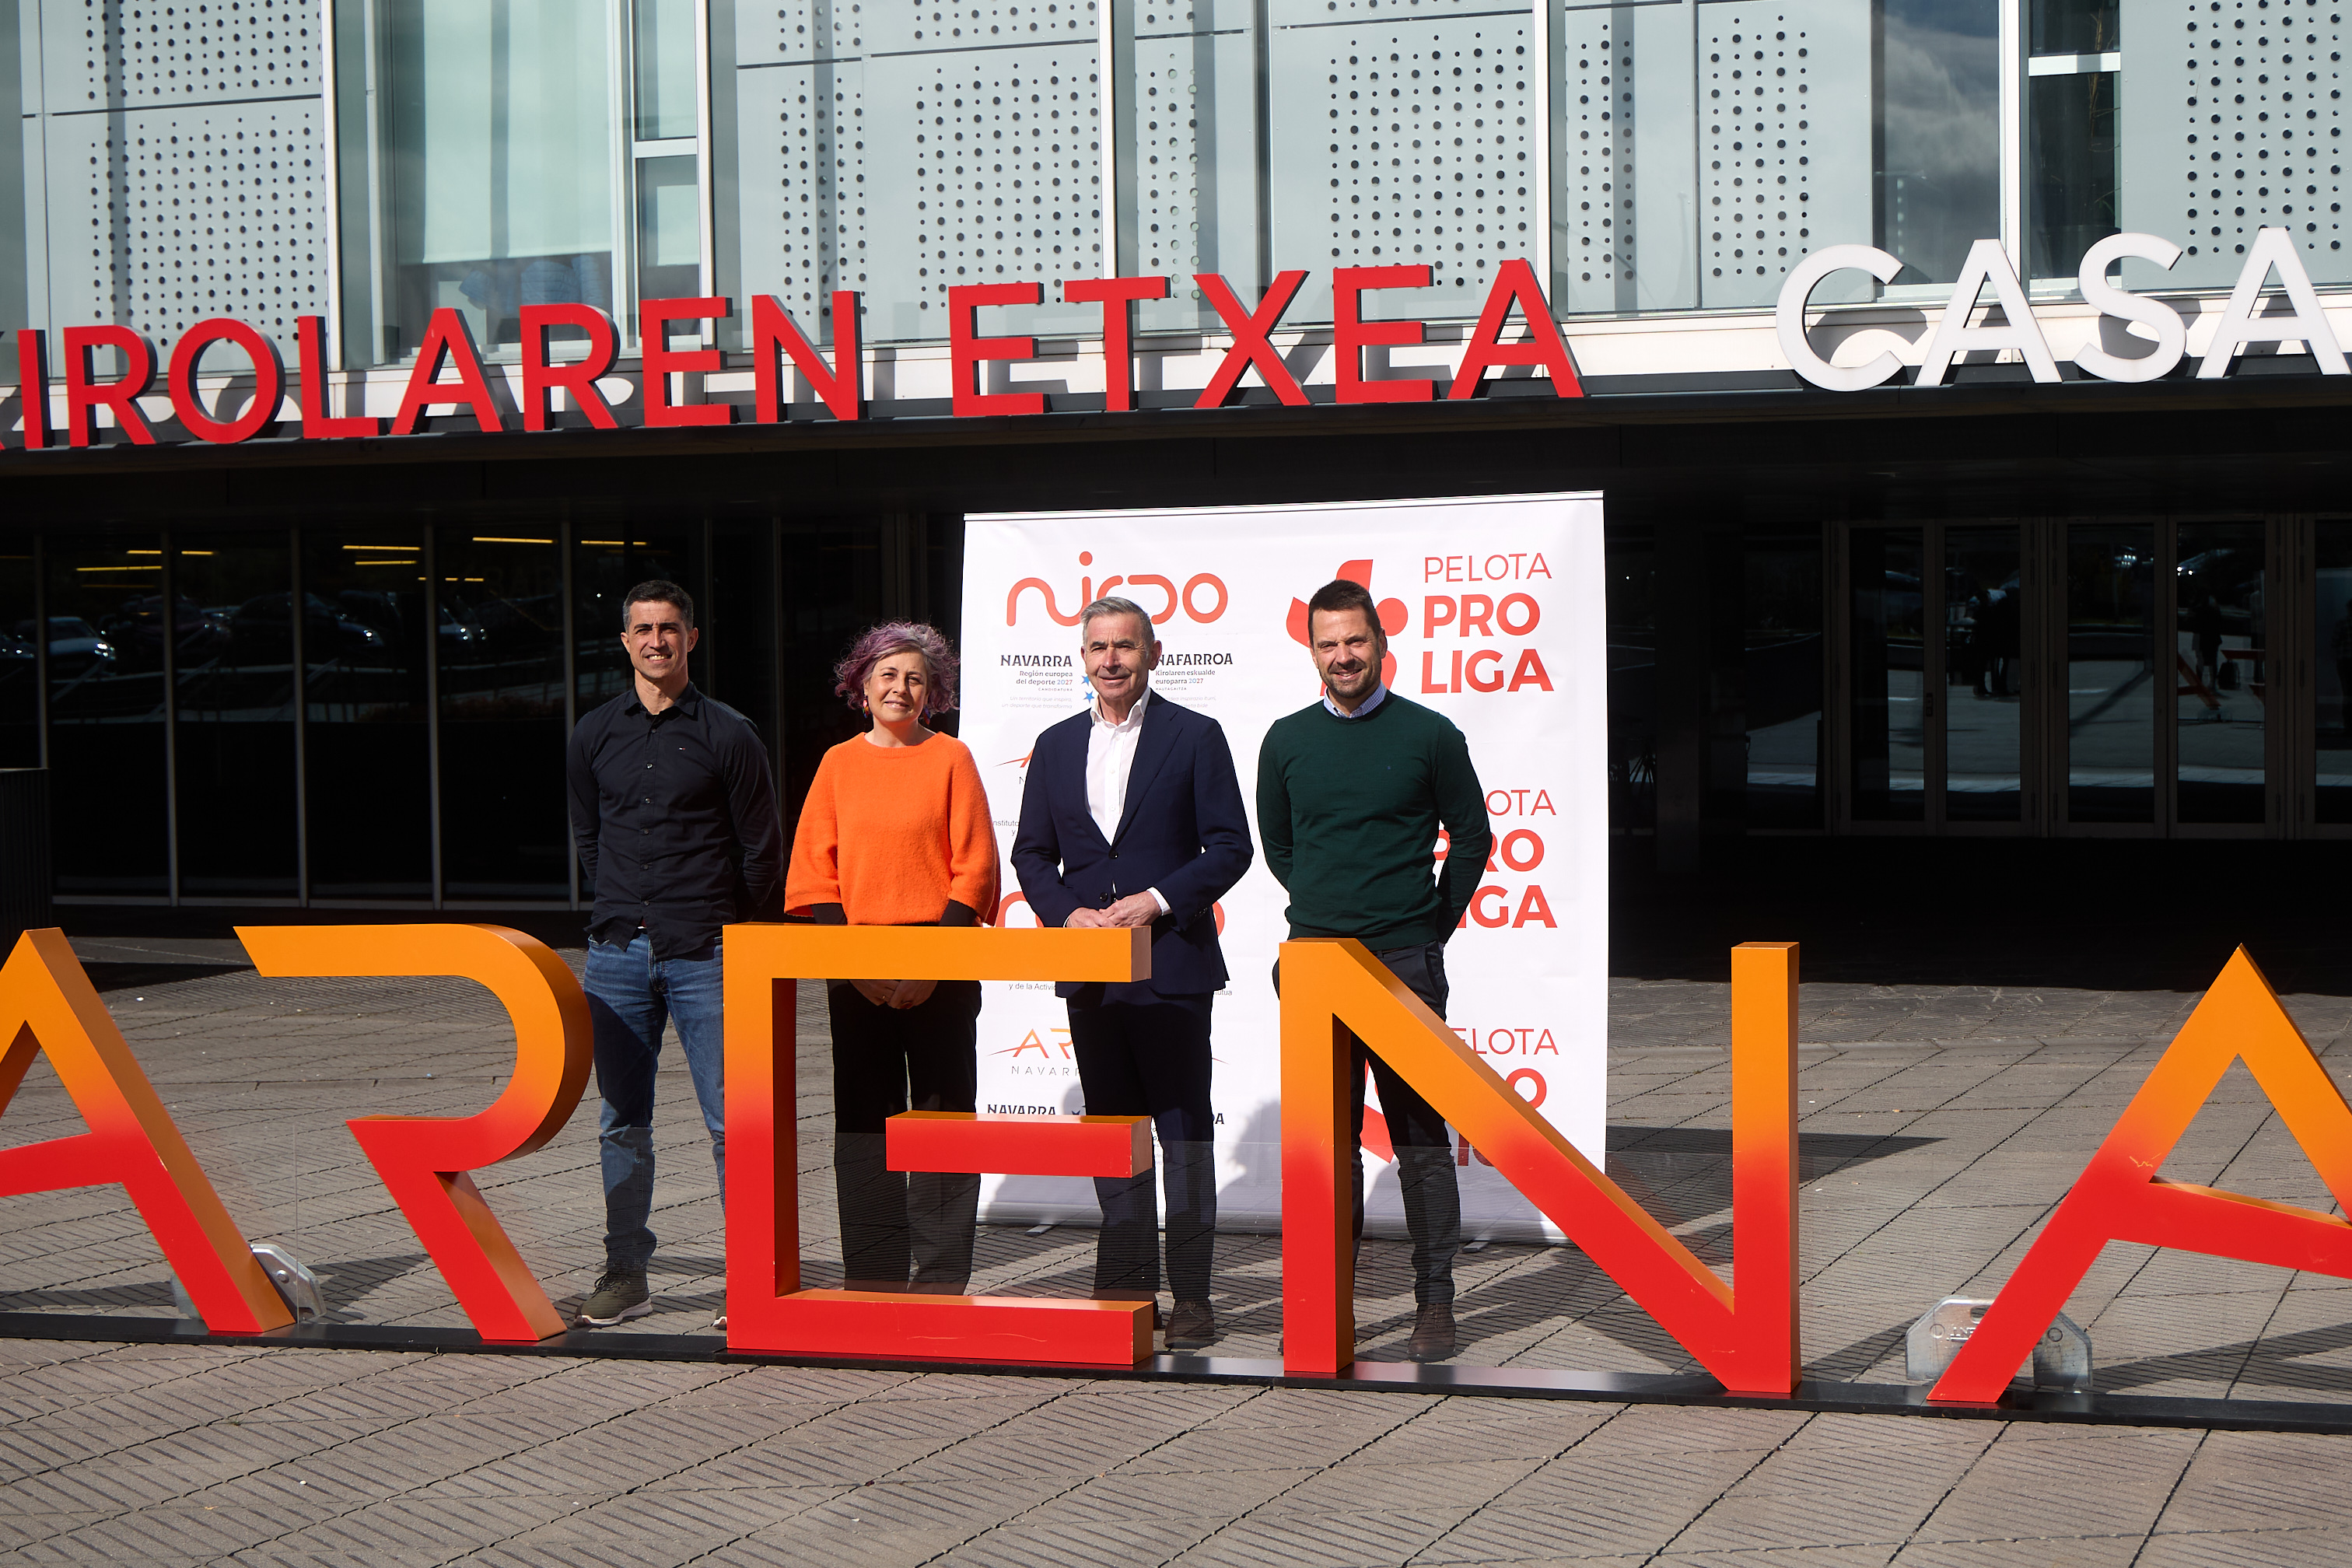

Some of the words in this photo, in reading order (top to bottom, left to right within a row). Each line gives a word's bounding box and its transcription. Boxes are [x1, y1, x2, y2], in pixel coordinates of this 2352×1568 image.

[1776, 227, 2351, 392] CASA
[0, 290, 860, 450] IROLAREN
[948, 259, 1585, 417] ETXEA
[1424, 552, 1552, 583] PELOTA
[1423, 593, 1541, 639] PRO
[1000, 655, 1073, 667] NAVARRA
[1160, 653, 1234, 666] NAFARROA
[1421, 649, 1554, 694] LIGA
[1456, 885, 1558, 928] GA
[0, 923, 2352, 1405] ARENA
